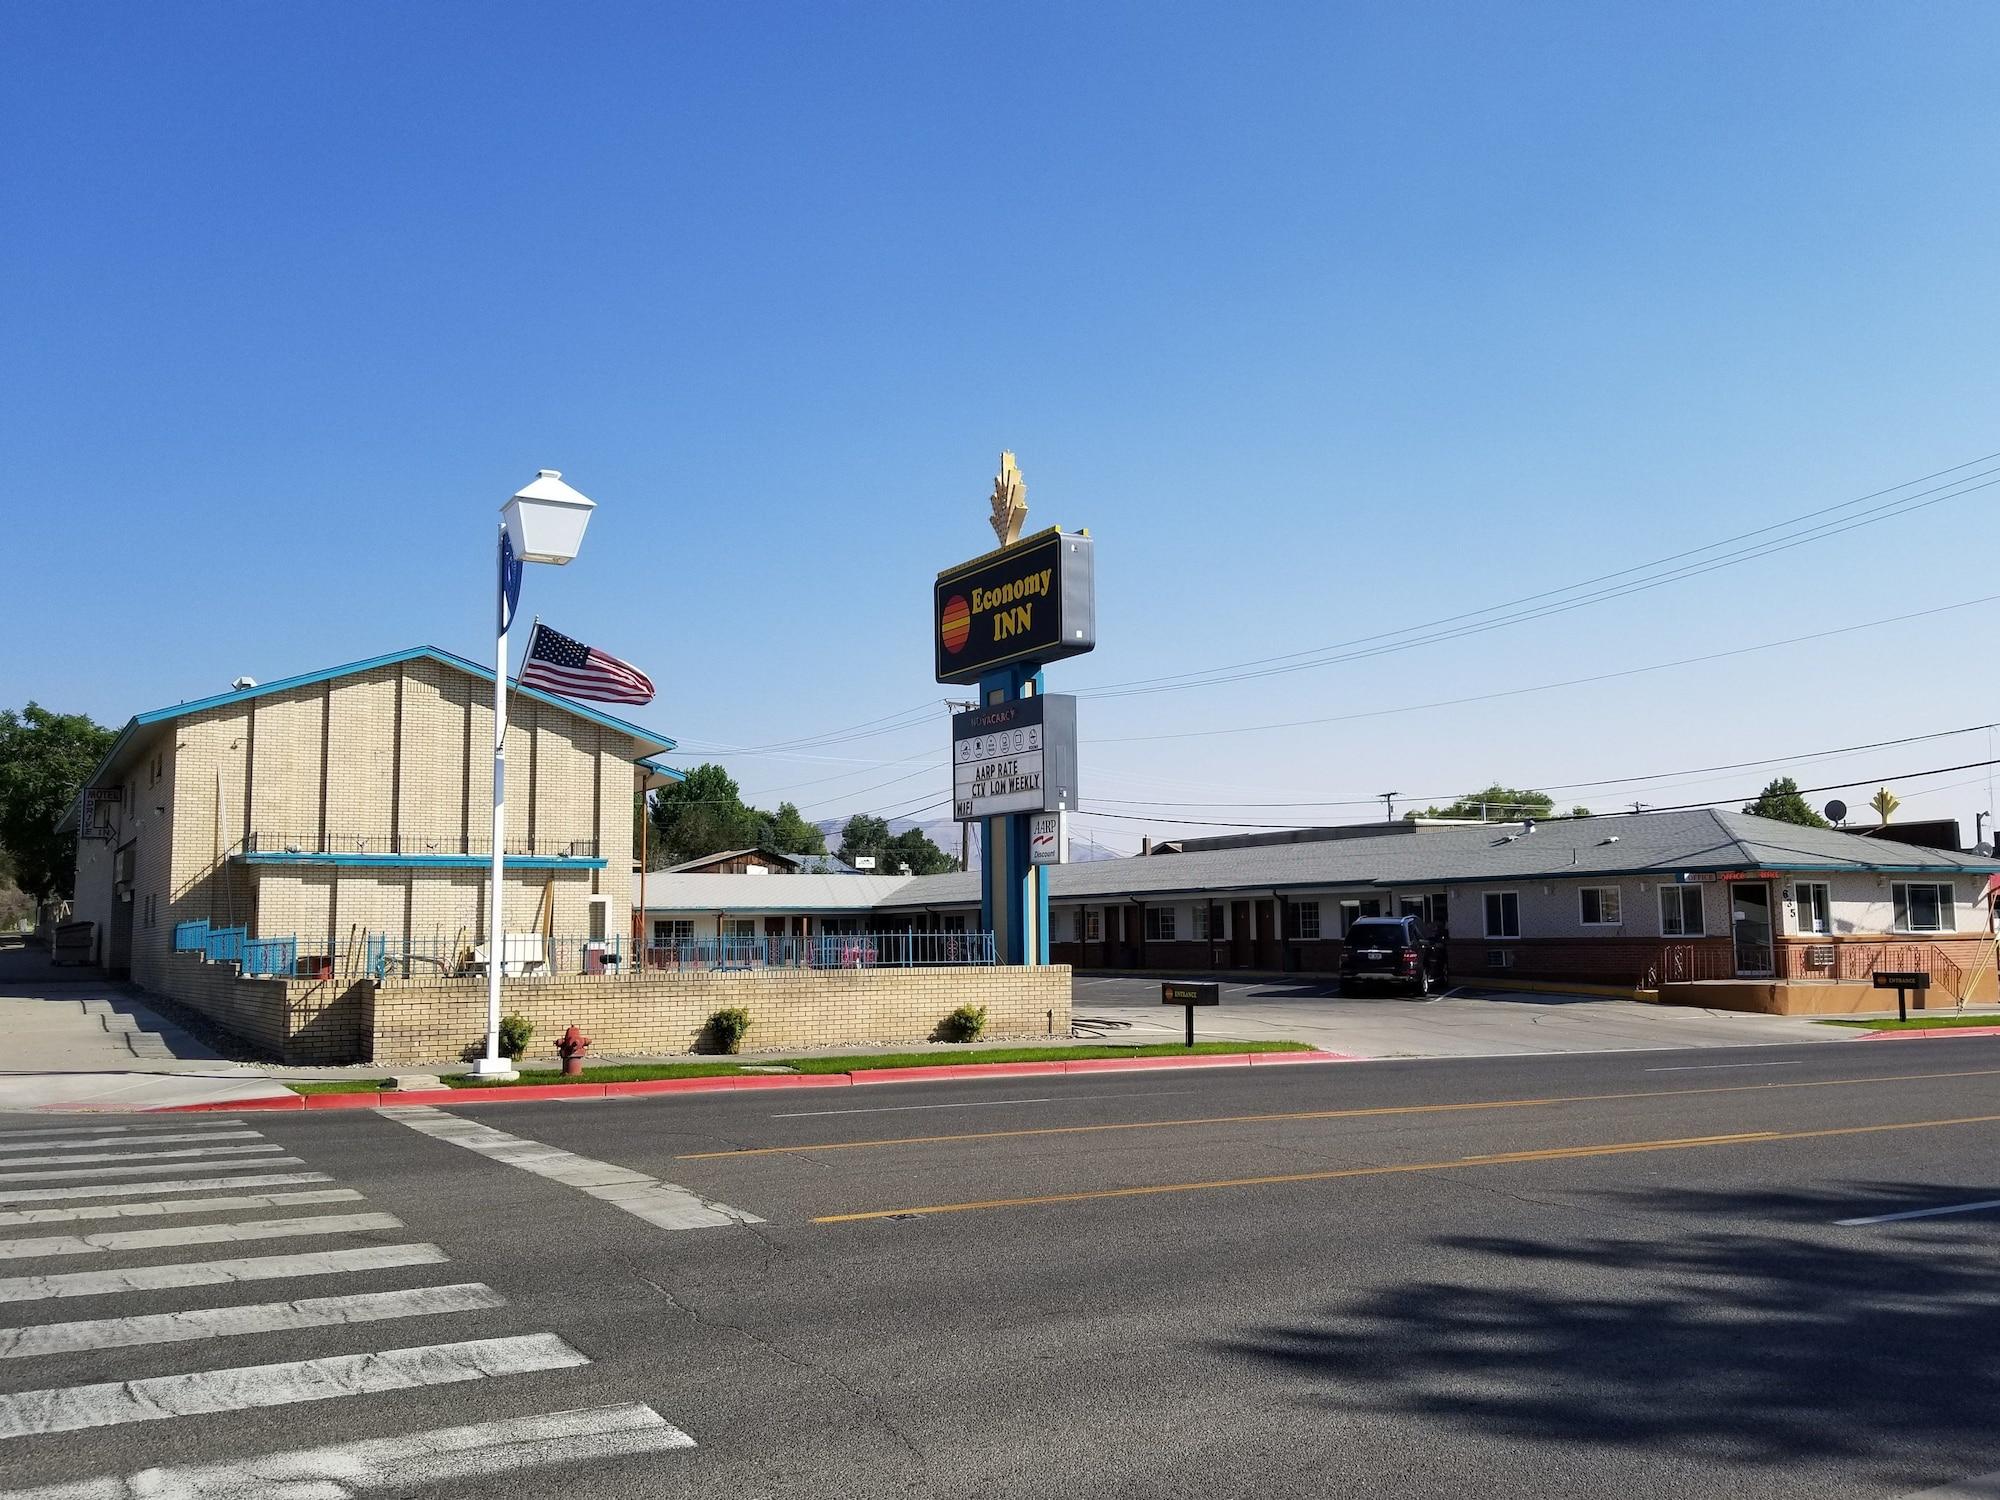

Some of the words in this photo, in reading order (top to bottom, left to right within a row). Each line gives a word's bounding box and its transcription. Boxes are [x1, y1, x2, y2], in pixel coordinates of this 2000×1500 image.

[971, 568, 1052, 615] Economy
[993, 603, 1032, 641] INN
[975, 764, 996, 780] AARP
[998, 760, 1018, 776] RATE
[1008, 773, 1040, 792] WEEKLY
[87, 790, 119, 799] MOTEL
[1034, 819, 1057, 834] AARP
[1034, 850, 1056, 858] Discount
